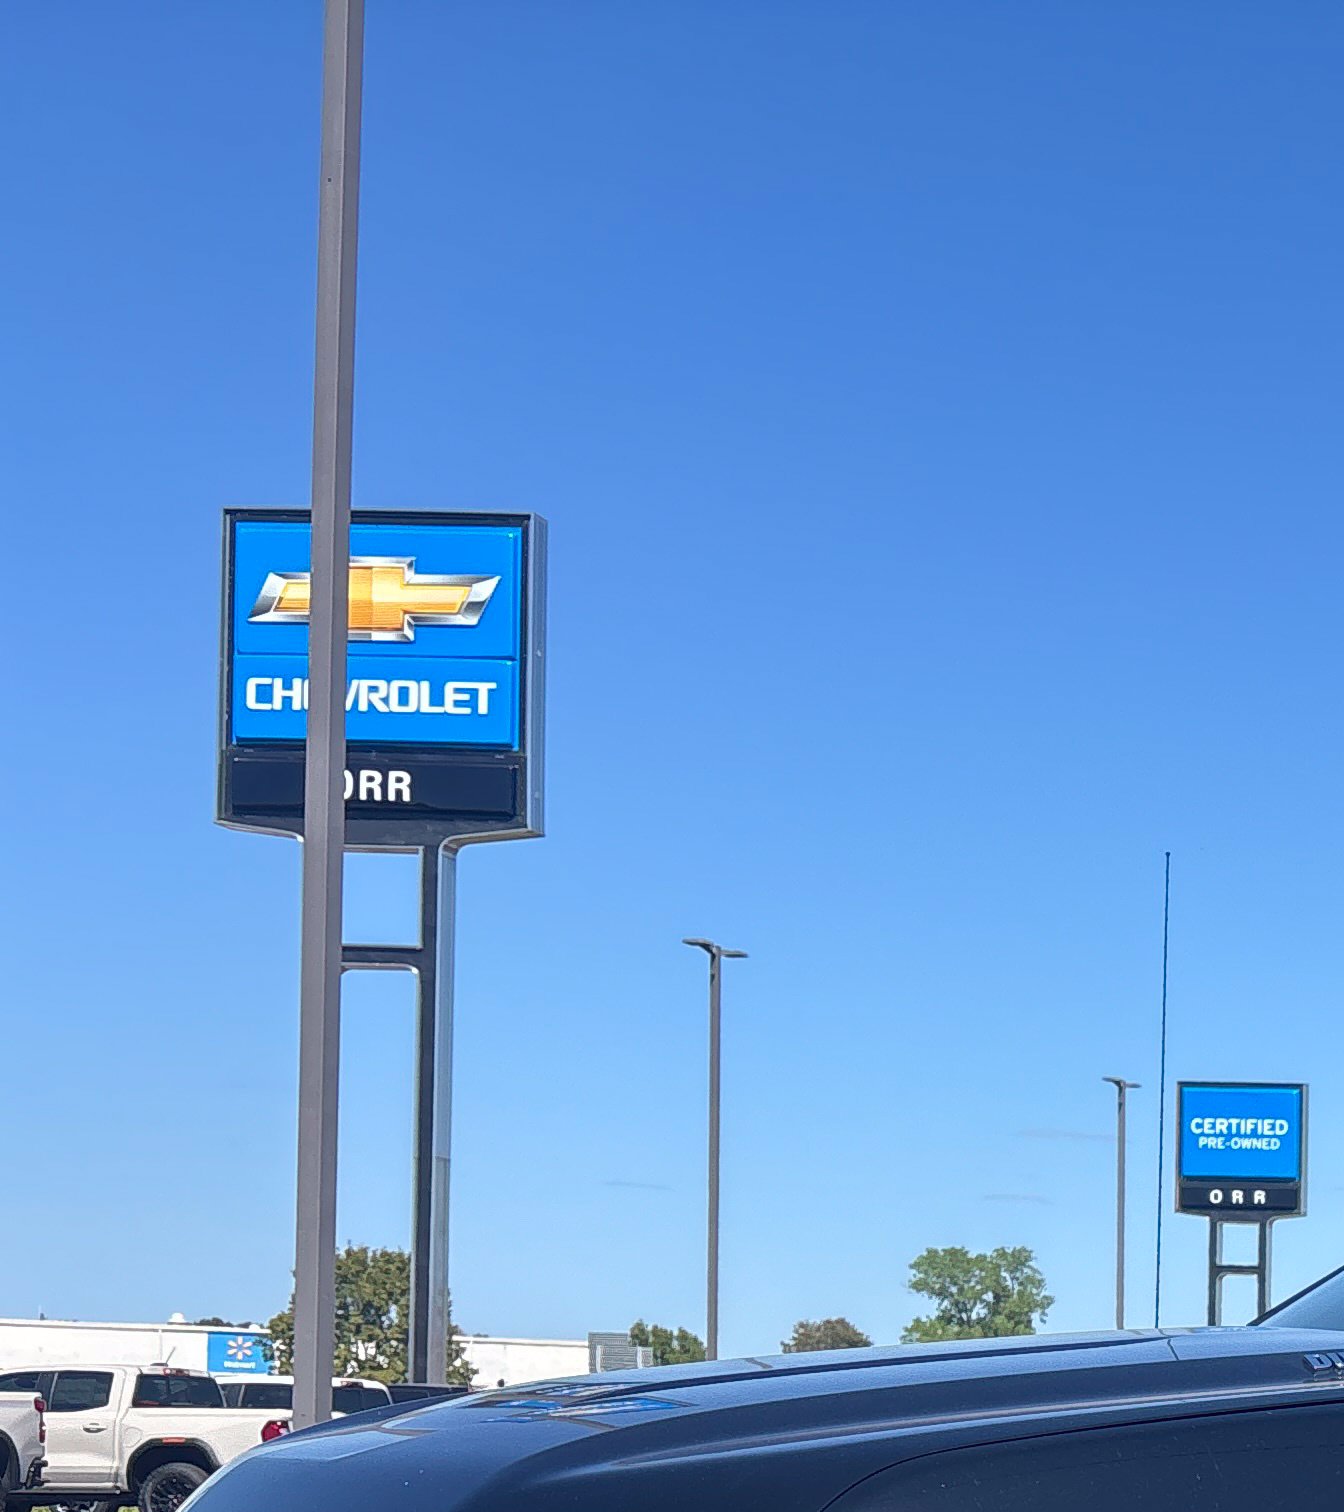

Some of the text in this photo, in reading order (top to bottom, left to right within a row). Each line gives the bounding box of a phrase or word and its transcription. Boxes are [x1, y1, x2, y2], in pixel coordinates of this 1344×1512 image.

[245, 677, 498, 715] CHROLET
[1190, 1117, 1289, 1136] CERTIFIED
[1198, 1136, 1281, 1150] PRE-OWNED
[1209, 1188, 1267, 1205] ORR
